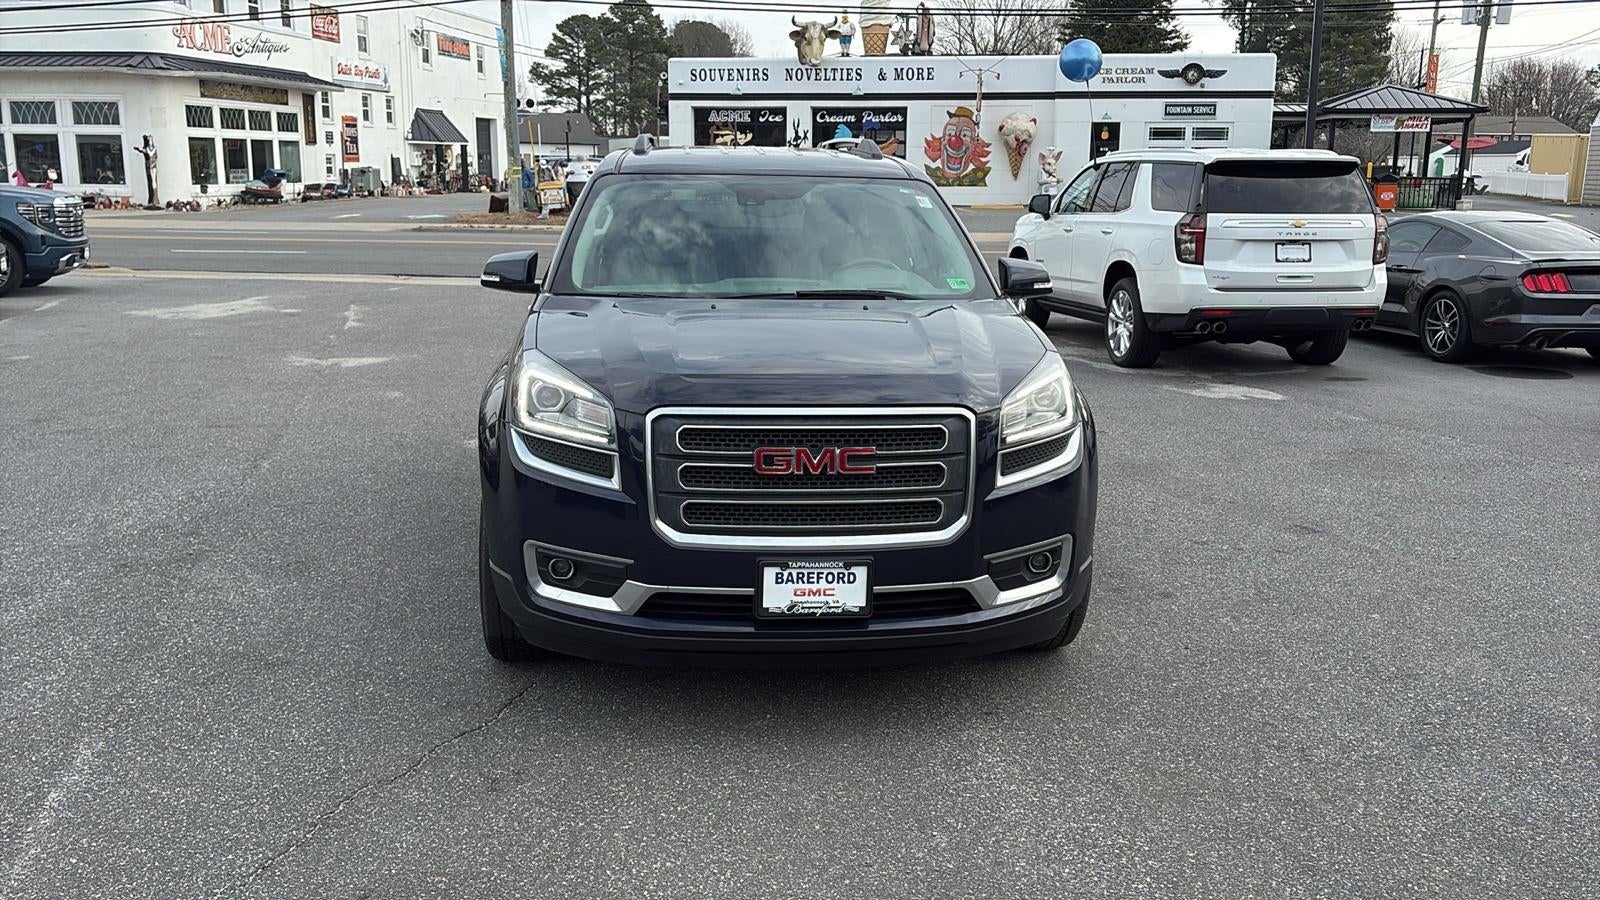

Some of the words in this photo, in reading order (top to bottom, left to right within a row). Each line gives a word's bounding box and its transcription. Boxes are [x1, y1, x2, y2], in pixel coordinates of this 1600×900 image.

[172, 18, 232, 55] ACME
[232, 32, 290, 60] Antiques
[337, 62, 352, 76] Dutch
[354, 64, 364, 80] Boy
[364, 66, 381, 80] Paints
[690, 67, 770, 82] SOUVENIRS
[785, 67, 863, 82] NOVELTIES
[877, 67, 888, 81] &
[893, 67, 935, 81] MORE
[1099, 67, 1112, 75] CE
[1115, 67, 1154, 75] CREAM
[1102, 76, 1146, 84] PARLOR
[708, 109, 751, 122] ACME
[758, 109, 785, 122] Ice
[816, 110, 857, 123] Cream
[861, 110, 904, 123] Parlor
[1166, 106, 1192, 114] FOUNTAIN
[1193, 106, 1215, 114] SERVICE
[1407, 115, 1430, 123] MILK
[345, 142, 358, 154] TEA
[753, 446, 877, 475] GMC
[774, 571, 857, 585] BAREFORD
[793, 588, 836, 597] GMC
[784, 602, 845, 616] Bareford
